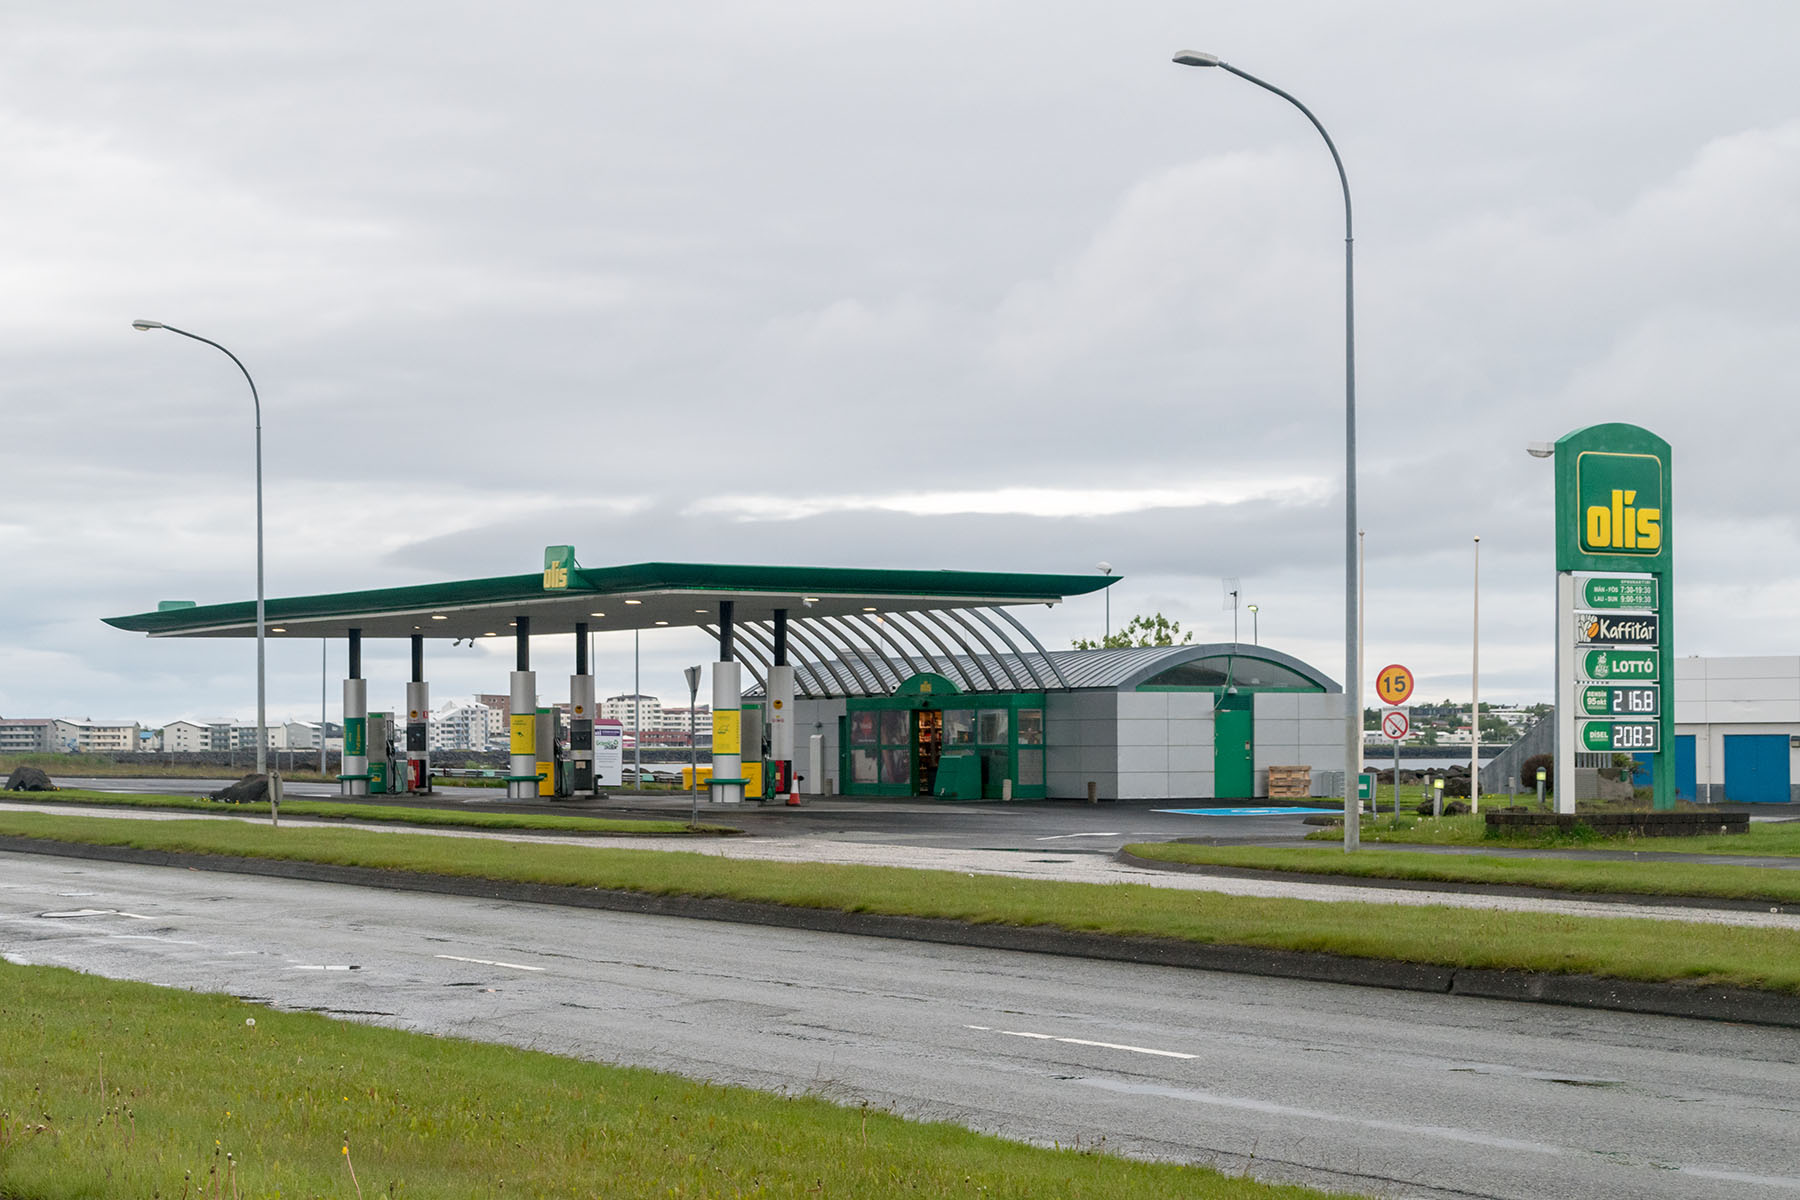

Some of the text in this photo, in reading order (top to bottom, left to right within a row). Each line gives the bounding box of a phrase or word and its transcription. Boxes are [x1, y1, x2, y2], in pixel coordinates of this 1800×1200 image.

[1587, 489, 1660, 549] olís
[1600, 618, 1655, 640] Kaffitár
[1612, 658, 1654, 673] LOTTÓ
[1384, 676, 1406, 693] 15
[1613, 690, 1653, 711] 216.8
[1613, 726, 1653, 747] 208.3
